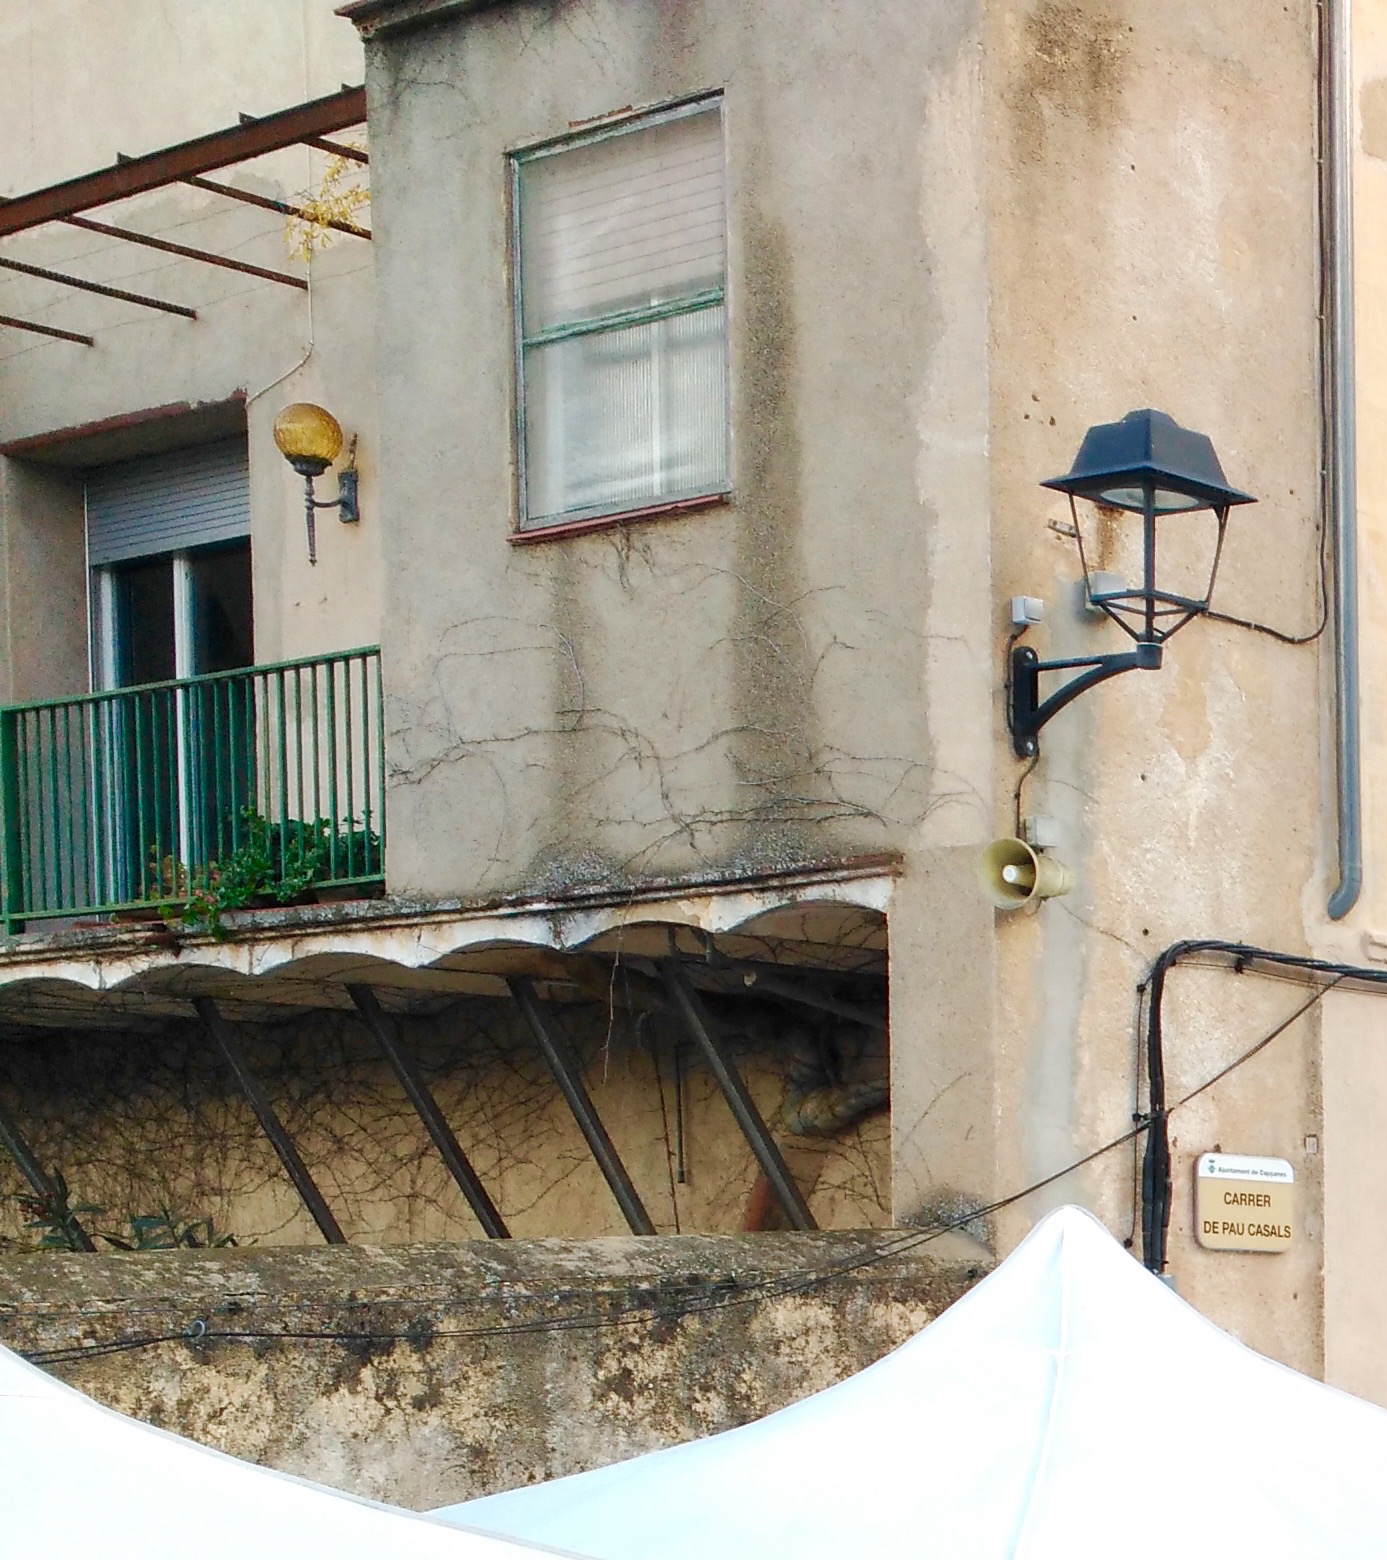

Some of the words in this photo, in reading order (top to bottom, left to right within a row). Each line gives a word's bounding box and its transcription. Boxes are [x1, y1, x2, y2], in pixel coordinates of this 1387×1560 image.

[1223, 1192, 1271, 1208] CARRER
[1203, 1220, 1219, 1235] DE
[1222, 1222, 1245, 1236] PAU
[1248, 1223, 1292, 1239] CASALS
